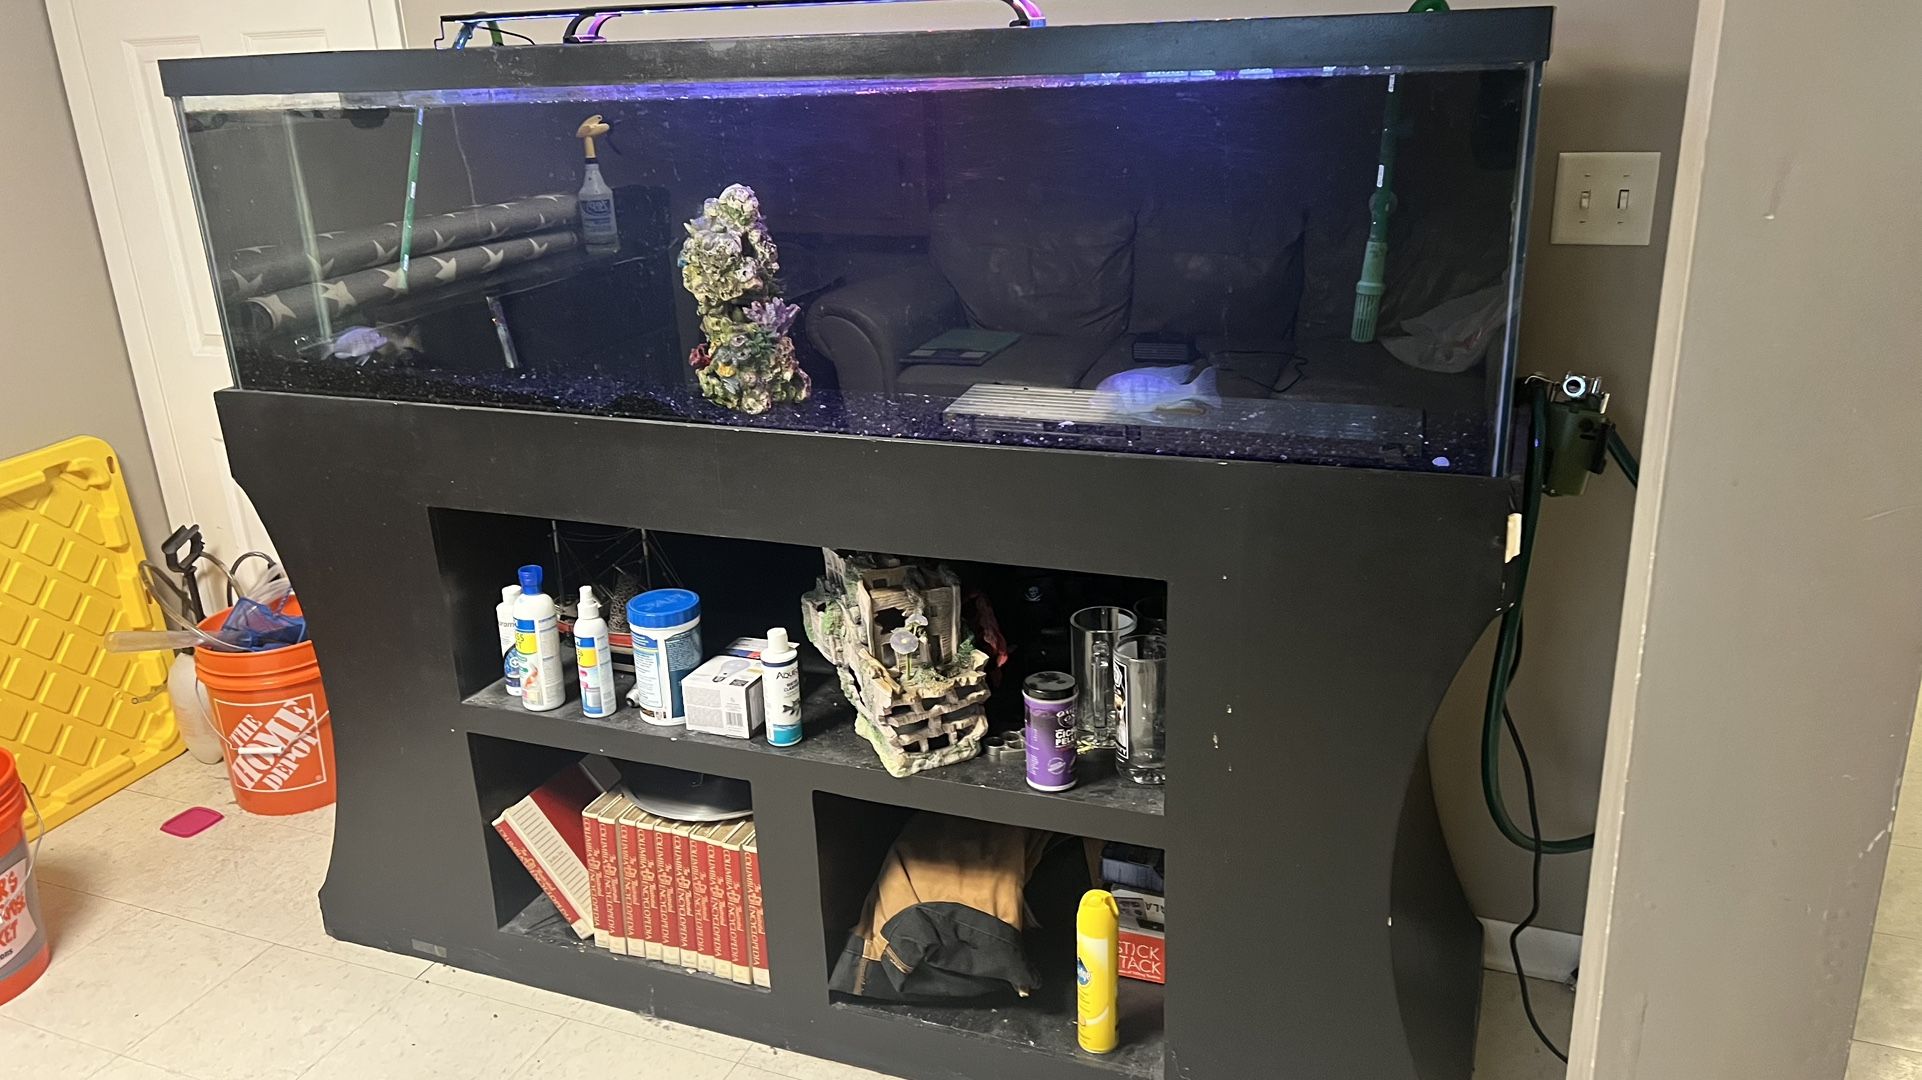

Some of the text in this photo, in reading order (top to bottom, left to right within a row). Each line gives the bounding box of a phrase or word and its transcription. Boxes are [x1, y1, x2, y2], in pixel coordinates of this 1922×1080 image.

[229, 714, 263, 747] THE
[232, 700, 314, 790] HOME
[262, 730, 319, 790] DEPOT
[584, 818, 593, 857] COLUMBIA
[600, 824, 615, 934] COLUMBIA ENCYCLOPEDIA
[620, 825, 634, 936] COLUMBIA ENCYCLOPEDIA
[638, 829, 652, 939] COLUMBIA ENCYCLOPEDIA
[656, 832, 670, 944] COLUMBIA ENCYCLOPEDIA
[674, 836, 687, 947] COLUMBIA ENCYCLOPEDIA
[690, 840, 704, 952] COLUMBIA ENCYCLOPEDIA
[708, 845, 721, 957] COLUMBIA ENCYCLOPEDIA
[723, 850, 738, 961] COLUMBIA ENCYCLOPEDIA
[745, 853, 759, 965] COLUMBIA ENCYCLOPEDIA
[1119, 940, 1160, 961] STICK
[1119, 955, 1161, 975] TACK
